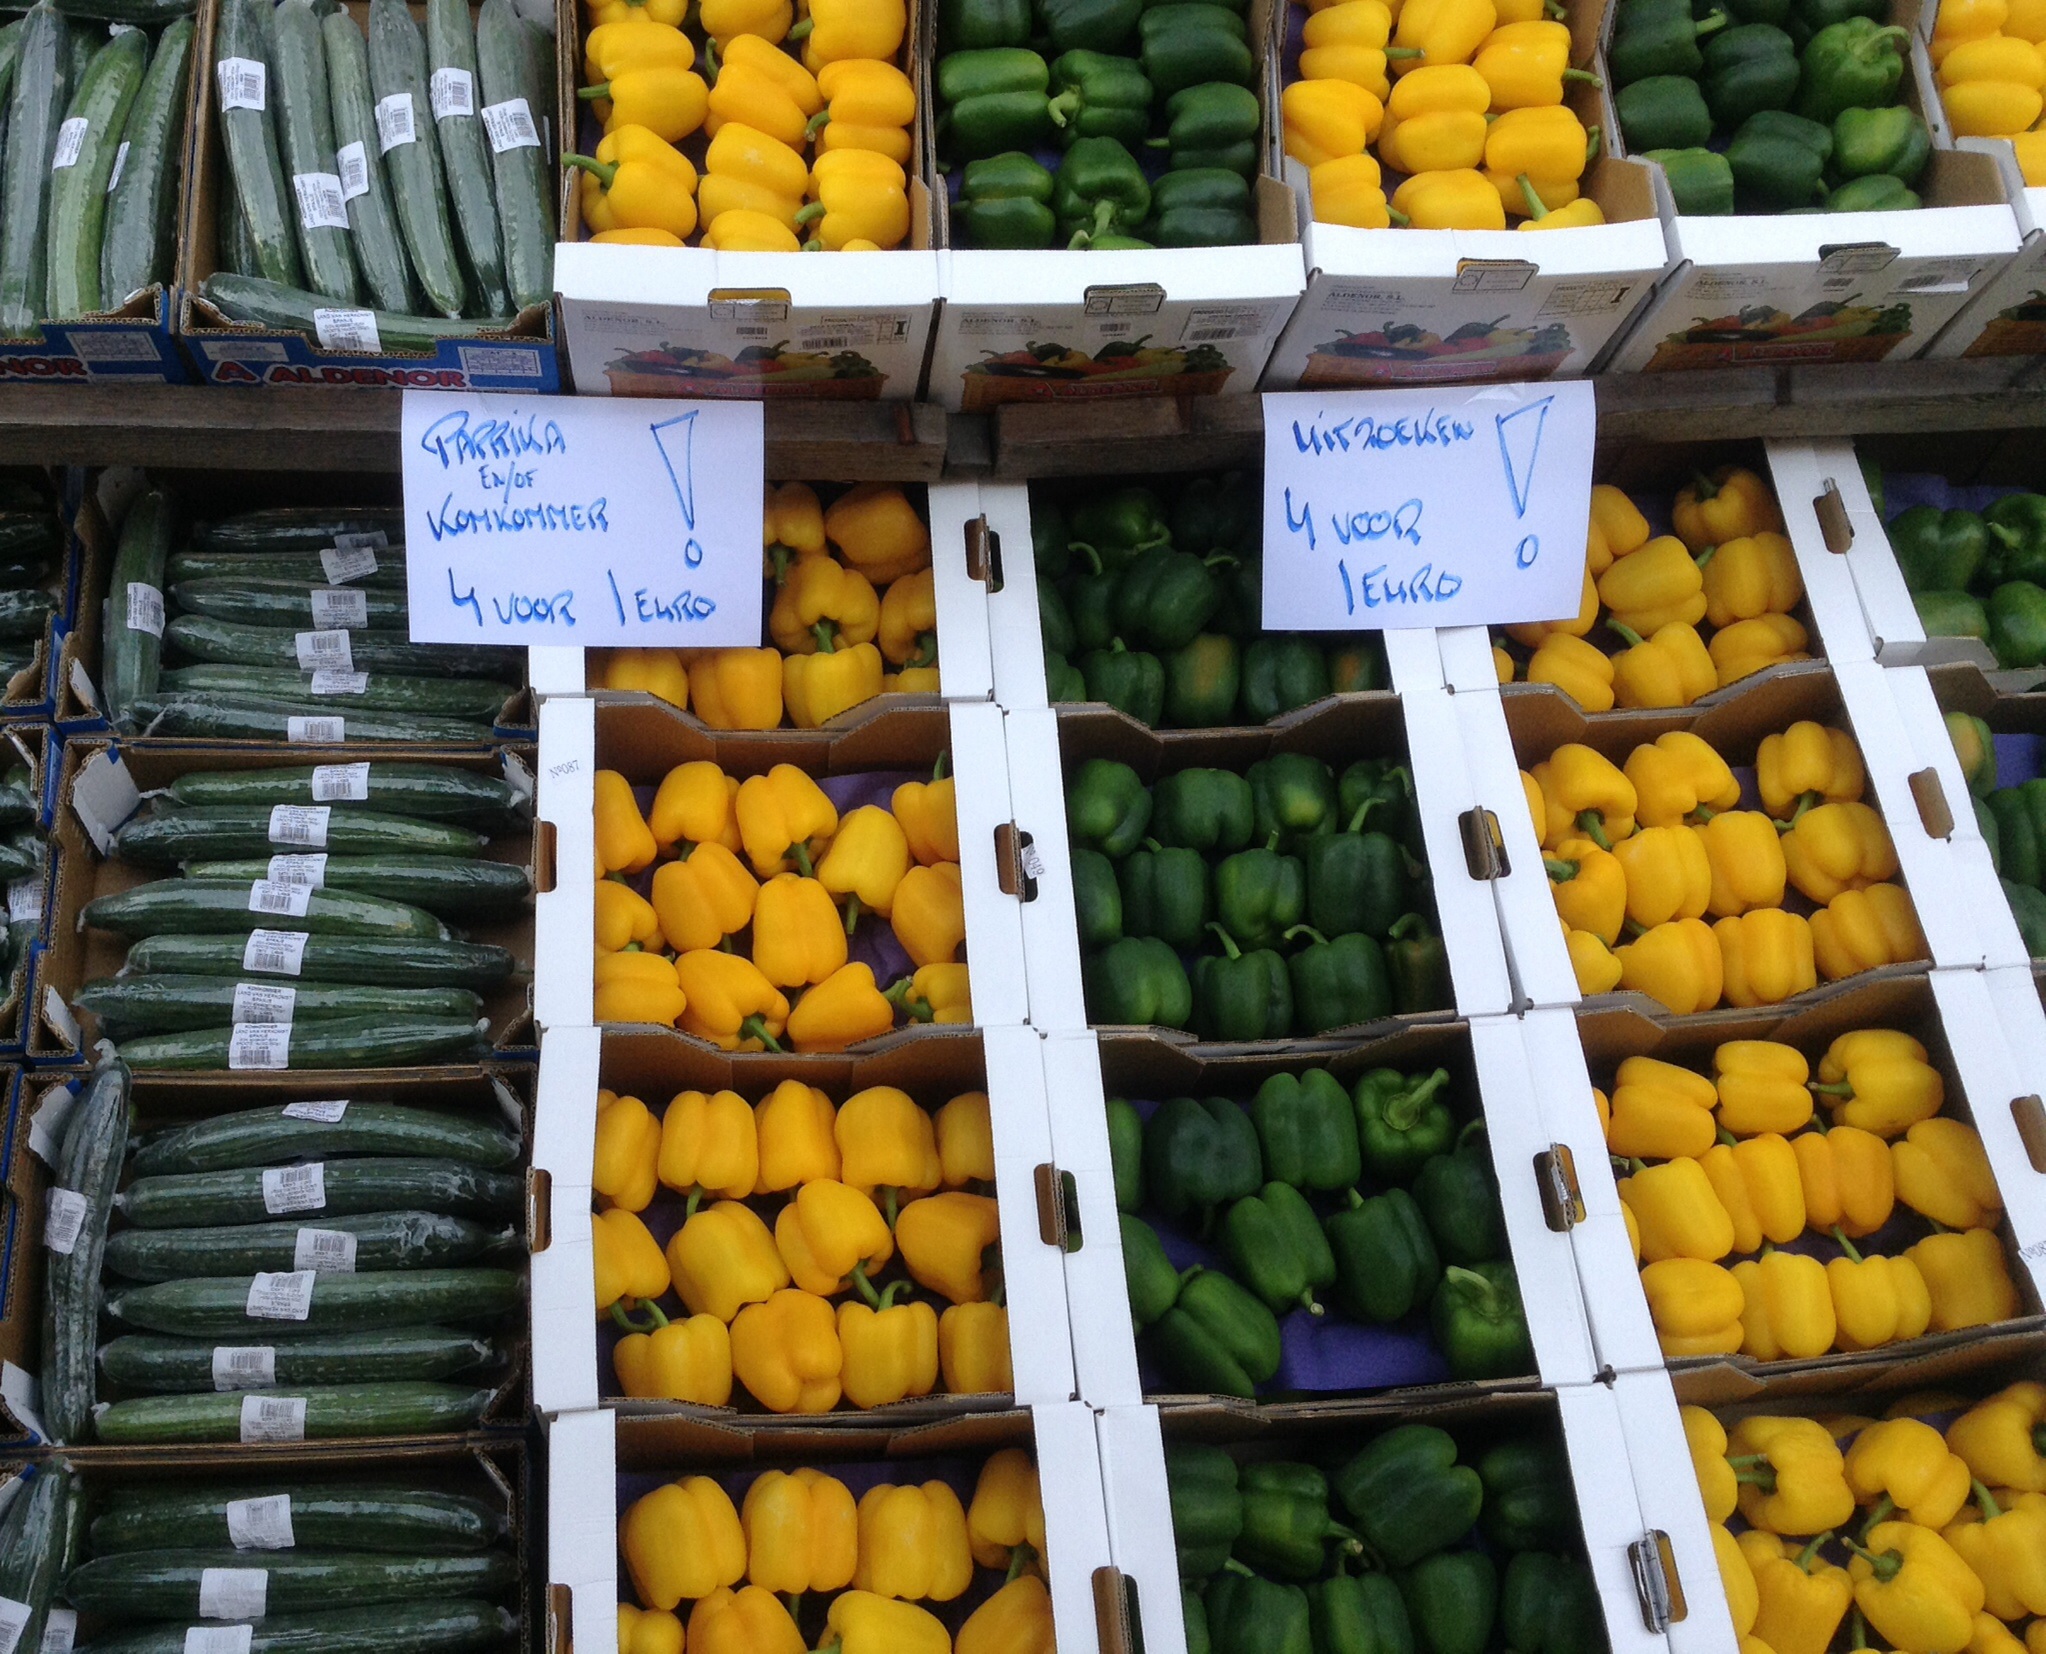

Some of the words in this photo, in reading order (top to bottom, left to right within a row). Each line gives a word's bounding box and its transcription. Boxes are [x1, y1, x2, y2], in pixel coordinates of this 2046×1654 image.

[271, 365, 467, 388] ALDENOR
[421, 409, 566, 469] PAPRIKA
[1292, 407, 1475, 456] UITZOEKEN
[479, 460, 539, 503] EN/OF
[426, 492, 609, 542] KOMKOMMER
[1284, 486, 1317, 551] 4
[1332, 498, 1424, 546] VOOR
[448, 566, 484, 627] 4
[493, 589, 576, 626] VOOR
[634, 588, 717, 623] EURO
[1362, 563, 1463, 609] EURO
